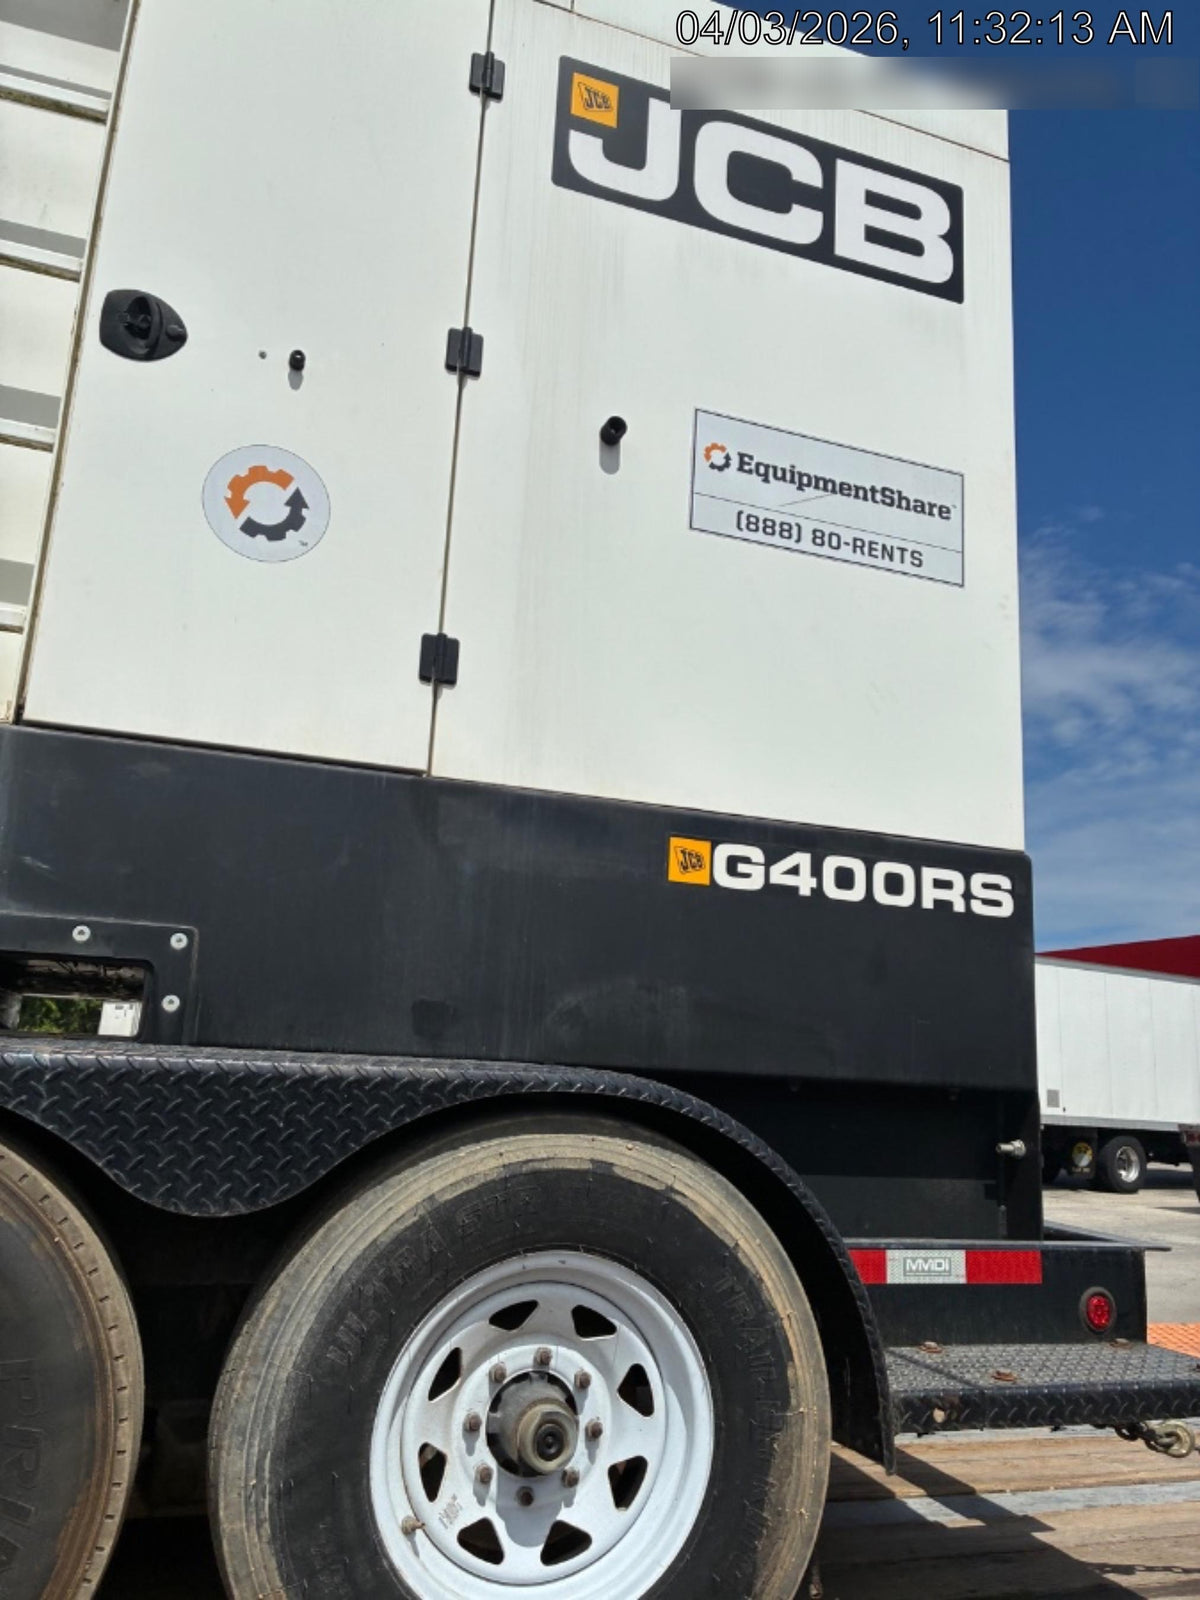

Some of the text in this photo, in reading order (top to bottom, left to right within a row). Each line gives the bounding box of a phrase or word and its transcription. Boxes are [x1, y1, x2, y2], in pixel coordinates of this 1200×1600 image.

[568, 97, 954, 284] JCB
[737, 451, 952, 521] EquipmentShare
[736, 510, 924, 568] (888) 80-RENTS
[712, 843, 1014, 918] G400RS
